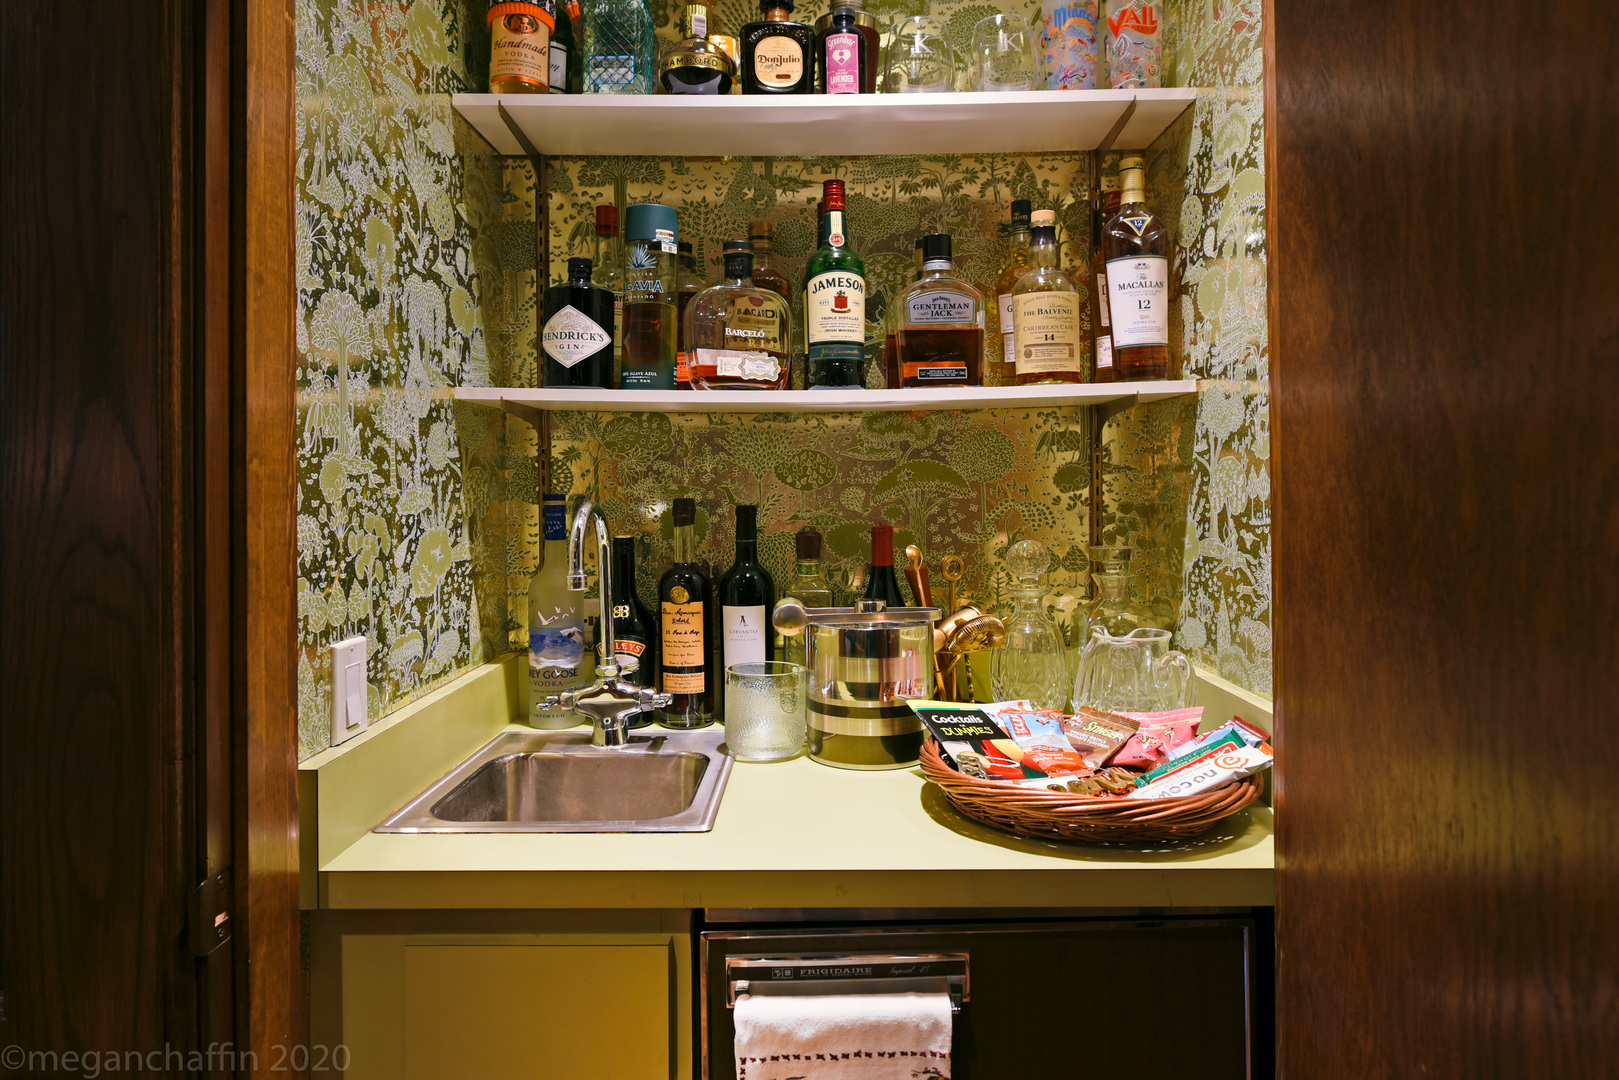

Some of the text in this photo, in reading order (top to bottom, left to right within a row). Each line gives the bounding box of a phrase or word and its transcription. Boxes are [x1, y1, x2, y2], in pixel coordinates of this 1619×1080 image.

[1107, 6, 1158, 38] VAIL
[494, 36, 547, 57] Handmade
[912, 34, 936, 54] K
[1000, 32, 1022, 52] K
[504, 51, 536, 60] VODKA
[662, 56, 719, 68] HAMBORD
[830, 74, 854, 84] LAVENDER
[812, 276, 864, 294] JAMESON
[1118, 281, 1164, 291] MACALLAN
[912, 302, 970, 310] GENTLEMAN
[1138, 300, 1151, 310] 12
[544, 331, 604, 342] HENDRICK'S
[542, 668, 578, 680] GOOSE
[931, 714, 984, 724] Cocktails
[940, 726, 994, 736] DUMMIES
[1082, 721, 1124, 742] STINGER
[1193, 768, 1218, 784] no
